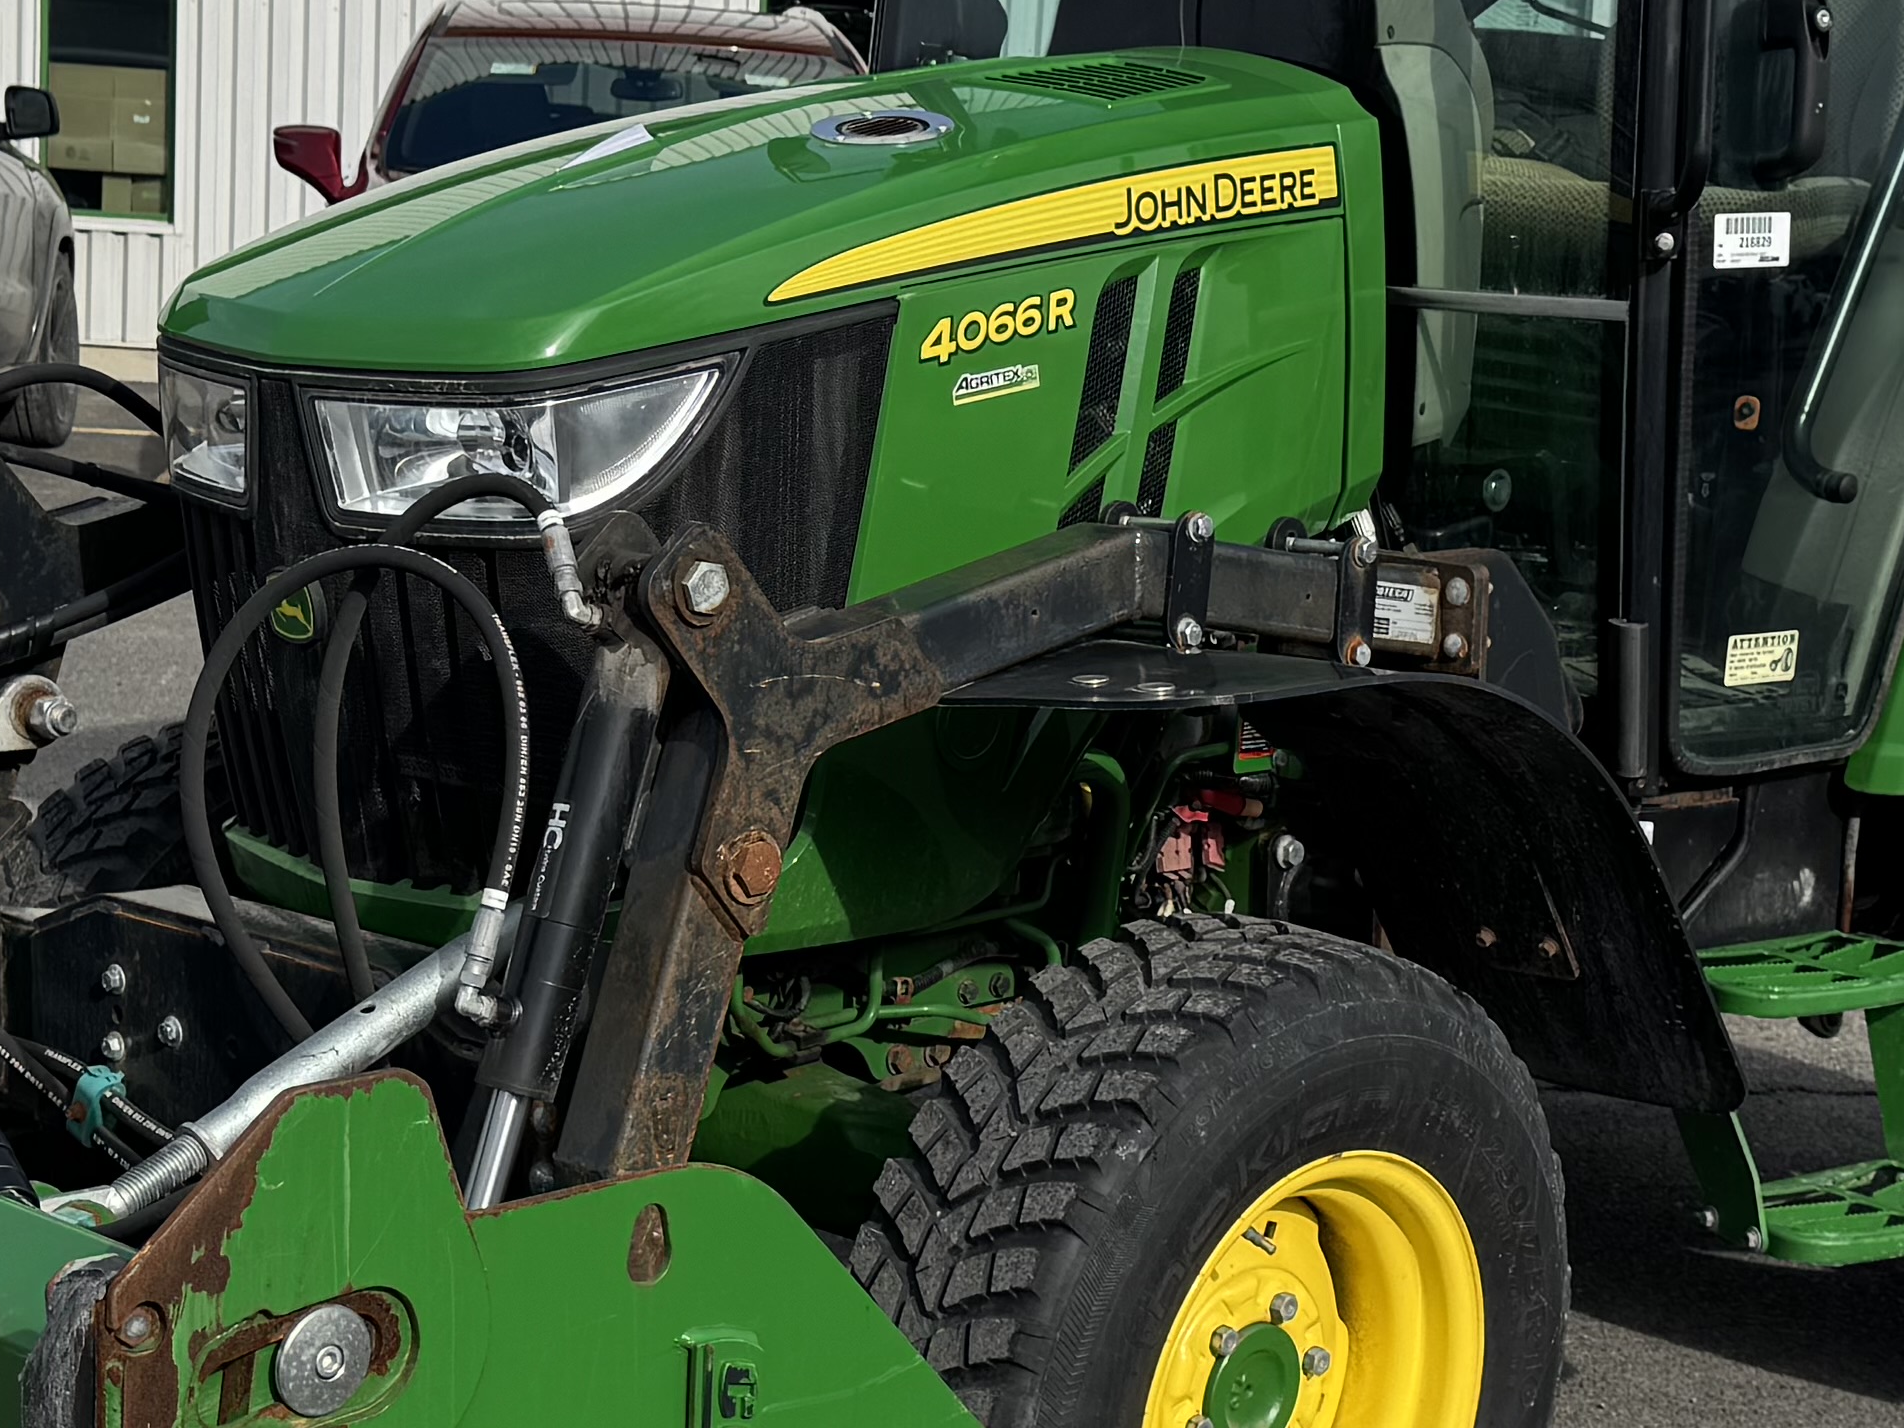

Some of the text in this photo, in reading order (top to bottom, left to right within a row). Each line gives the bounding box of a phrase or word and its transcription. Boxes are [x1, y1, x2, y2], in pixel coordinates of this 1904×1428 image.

[1114, 168, 1317, 230] JOHN DEERE
[955, 367, 1021, 394] AGRITEX
[491, 613, 520, 671] TRANSFLEX
[1731, 634, 1796, 650] ATTENTION
